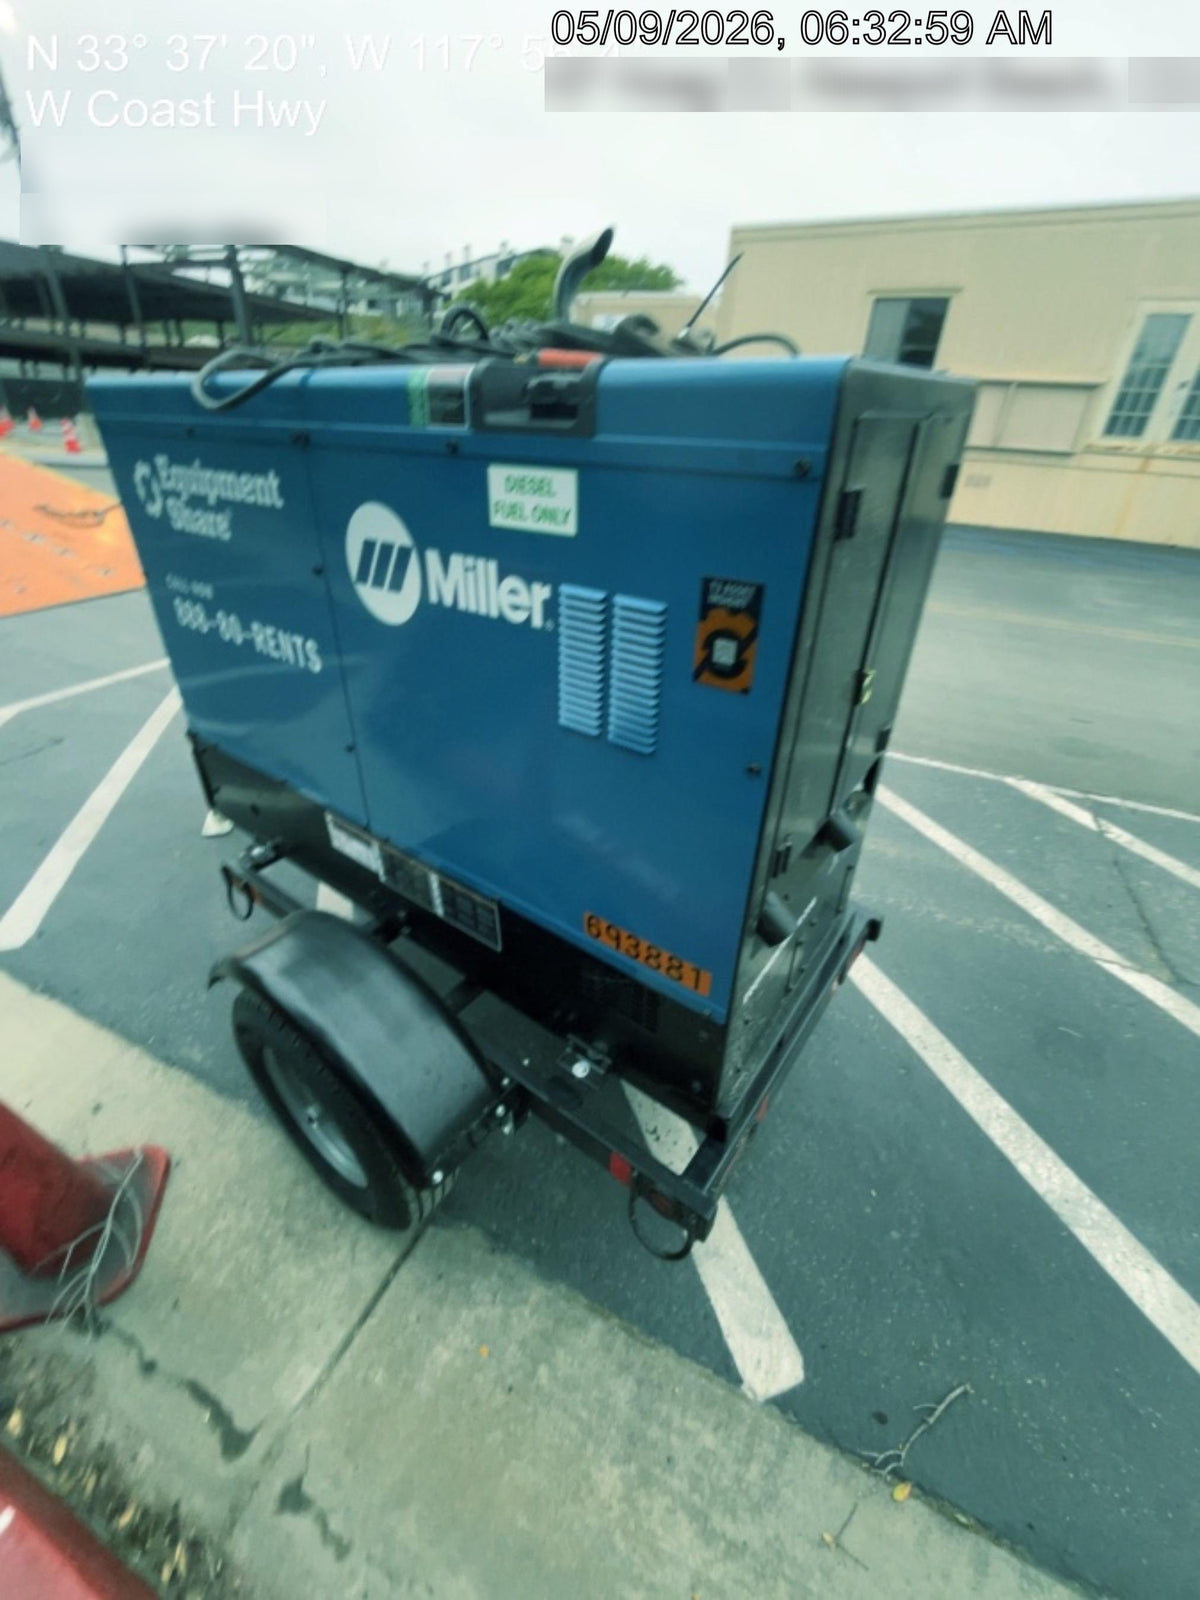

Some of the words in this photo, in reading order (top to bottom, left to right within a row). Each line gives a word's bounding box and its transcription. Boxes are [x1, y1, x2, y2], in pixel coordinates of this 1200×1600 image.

[154, 454, 284, 509] Equipment
[504, 474, 557, 498] DIESEL
[493, 500, 529, 521] FUEL
[531, 504, 571, 527] ONLY
[587, 914, 701, 991] 693881
